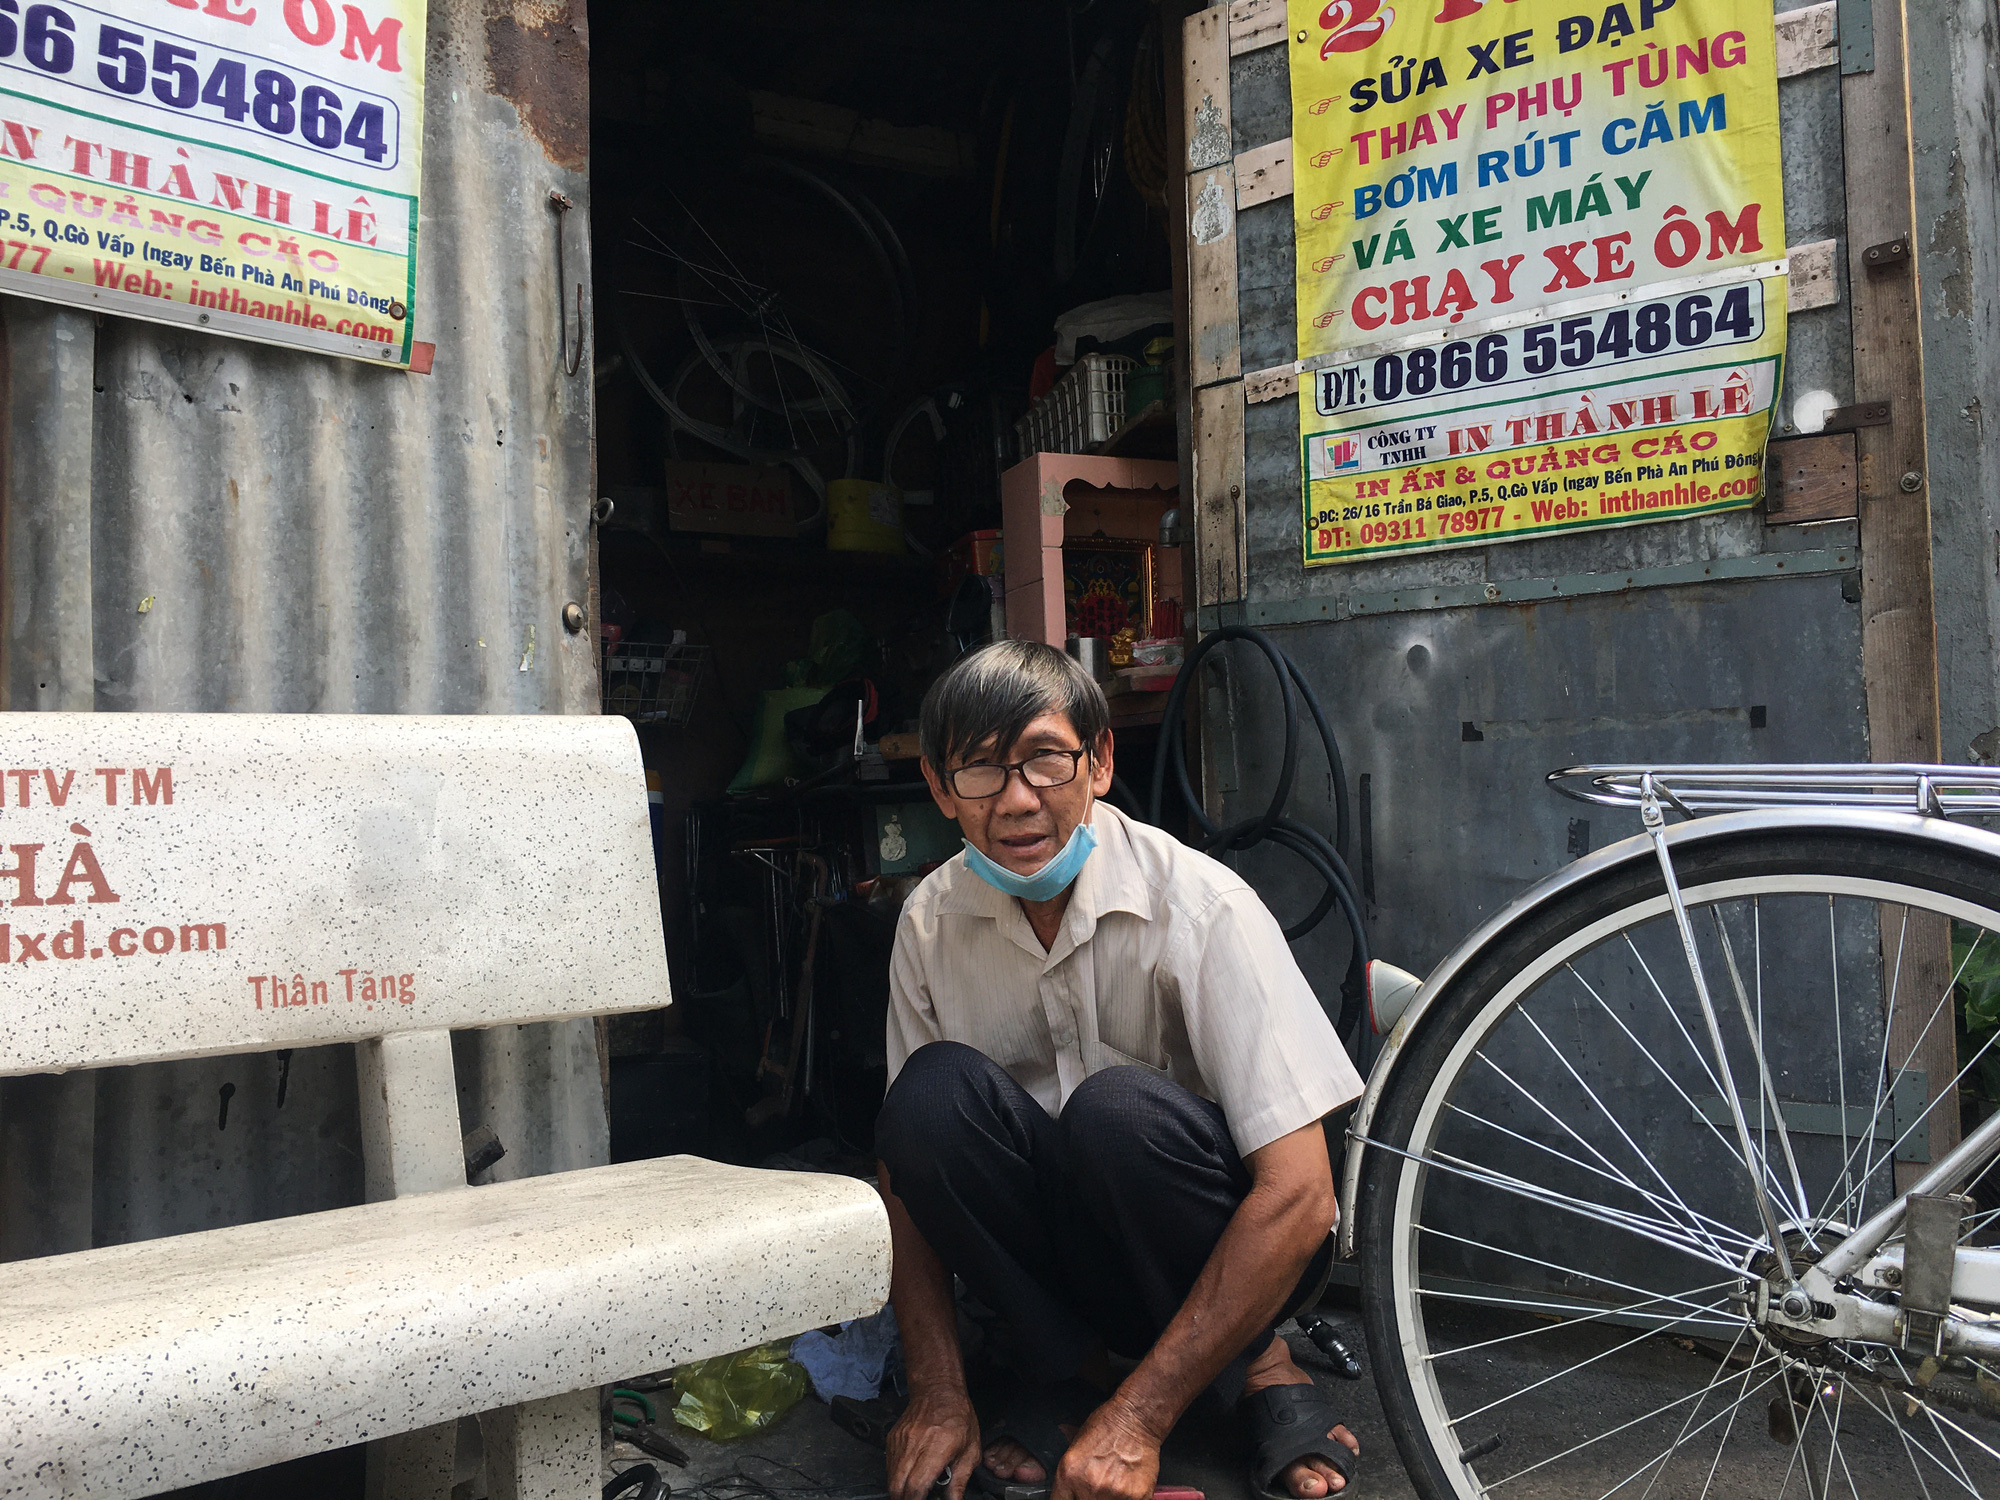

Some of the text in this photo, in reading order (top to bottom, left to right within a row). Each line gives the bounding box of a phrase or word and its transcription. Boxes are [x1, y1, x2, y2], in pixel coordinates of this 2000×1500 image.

[97, 23, 388, 163] 554864
[1349, 55, 1448, 113] SỬA
[1466, 29, 1534, 80] XE
[1556, 0, 1676, 54] ĐẠP
[1350, 30, 1747, 166] THAY PHỤ TÙNG
[63, 135, 294, 226] THÀNH
[311, 194, 378, 248] LÊ
[1353, 93, 1727, 221] BƠM RÚT CĂM
[28, 183, 340, 273] QUẢNG CÁO
[43, 219, 90, 245] Q.Gò
[97, 230, 135, 258] Vấp
[143, 241, 193, 272] (ngay
[200, 253, 235, 278] Bến
[242, 263, 275, 287] Phà
[281, 272, 303, 293] An
[309, 278, 340, 302] Phú
[1351, 170, 1654, 271] VÁ XE MÁY
[0, 239, 52, 275] 77
[93, 257, 173, 301] Web:
[188, 279, 394, 344] inthanhle.com
[1351, 203, 1764, 331] CHẠY XE ÔM
[1322, 286, 1755, 411] ĐT: 0866 554864
[1367, 425, 1437, 450] CÔNG TY
[1379, 446, 1427, 466] TNHH
[1446, 370, 1752, 456] IN THÀNH LÊ
[675, 481, 720, 510] XE
[1355, 430, 1718, 499] IN ẤN & QUẢNG CÁO
[1384, 498, 1412, 516] Trần
[1416, 496, 1432, 512] Bá
[1469, 487, 1493, 505] P.5,
[1497, 481, 1528, 501] Q.Gò
[1532, 476, 1558, 495] Vấp
[1563, 474, 1599, 494] (ngay
[1604, 468, 1632, 486] Bến
[1637, 464, 1664, 481] Phà
[1668, 461, 1688, 477] An
[1692, 456, 1719, 474] Phú
[1318, 526, 1351, 550] ĐT:
[1360, 517, 1427, 545] 09311
[1438, 505, 1505, 535] 78977
[1530, 495, 1588, 523] Web:
[1599, 474, 1760, 515] inthanhle.com
[0, 768, 173, 807] TV TM
[247, 969, 416, 1011] Thân Tặng
